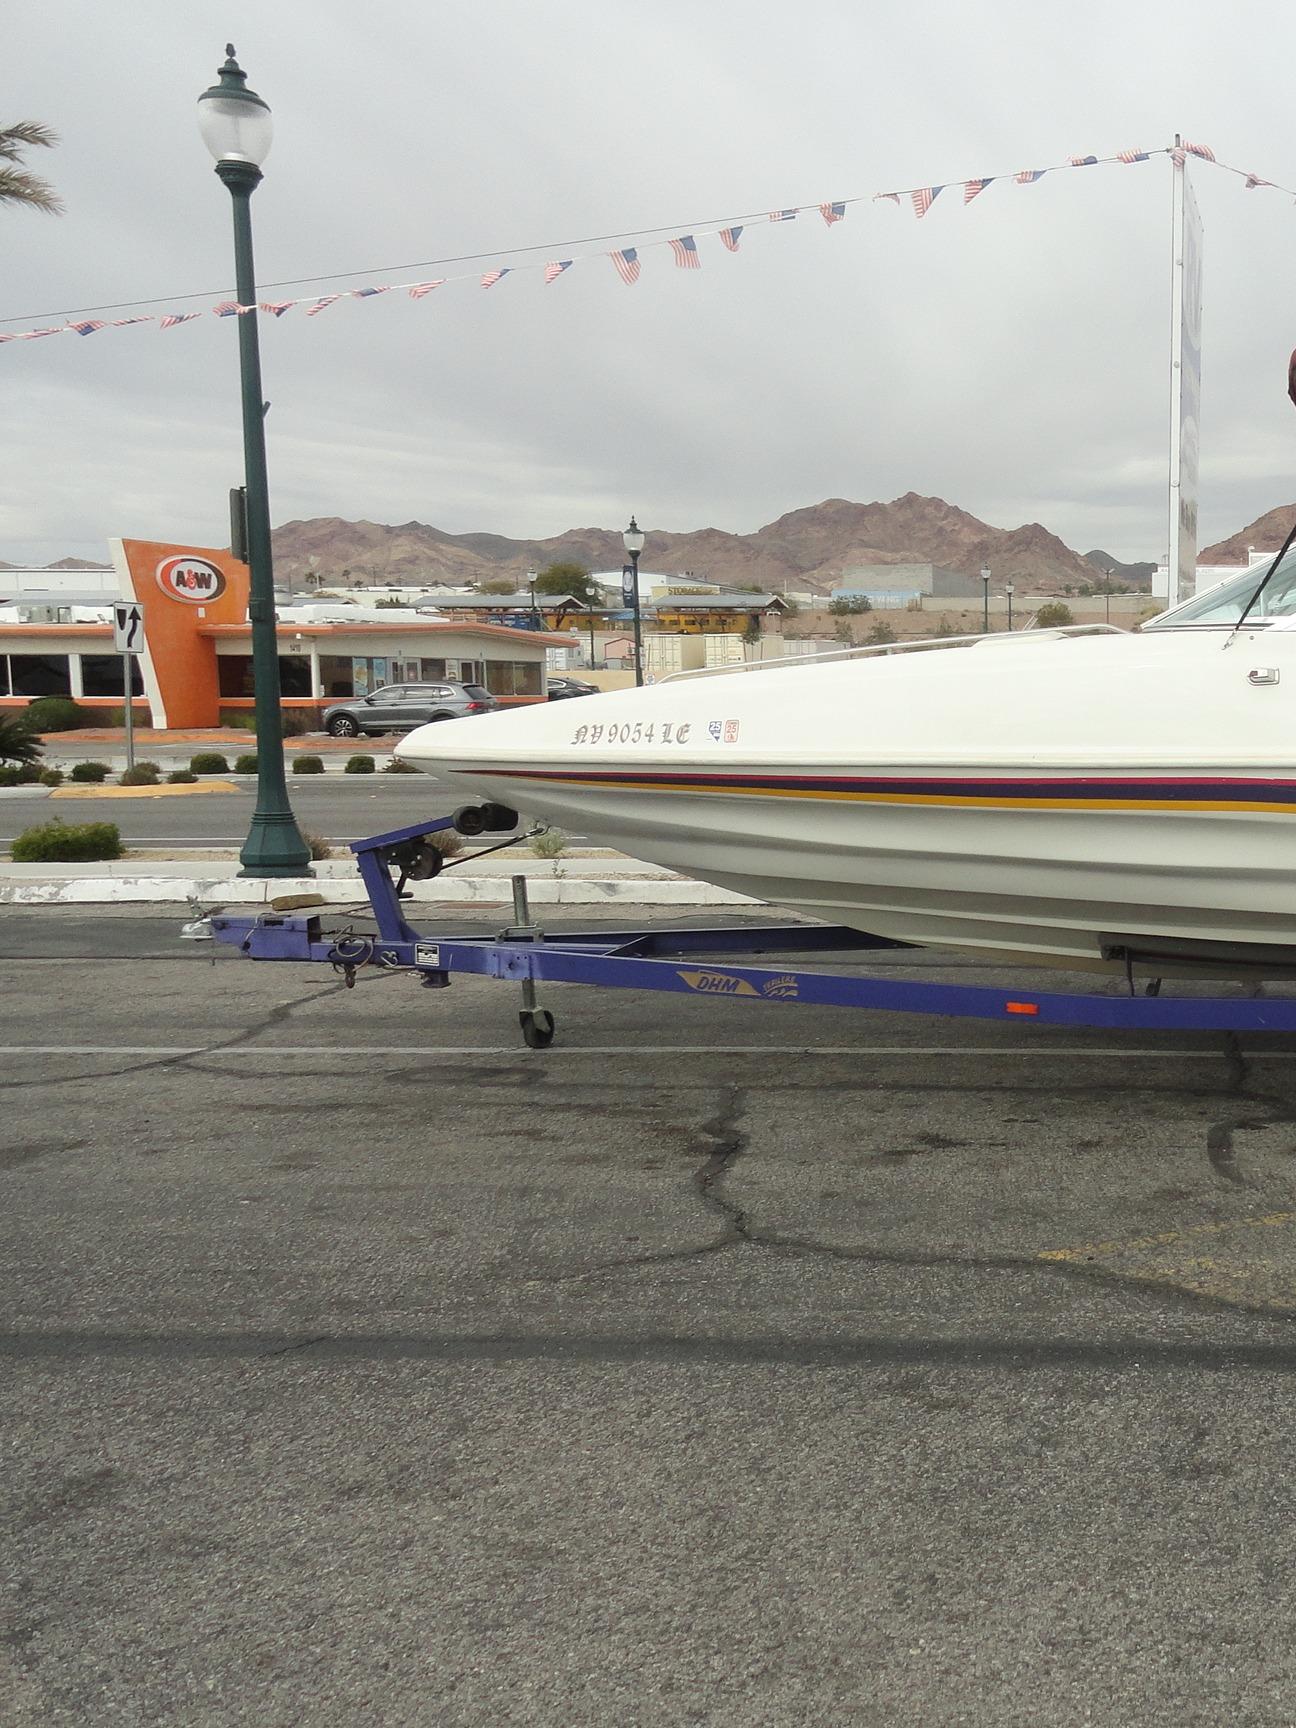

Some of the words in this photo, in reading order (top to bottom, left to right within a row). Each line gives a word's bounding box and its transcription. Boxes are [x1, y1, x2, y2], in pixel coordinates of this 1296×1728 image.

[176, 569, 212, 590] A&W
[570, 724, 604, 745] NV
[607, 722, 655, 744] 9054
[697, 976, 740, 992] DHM
